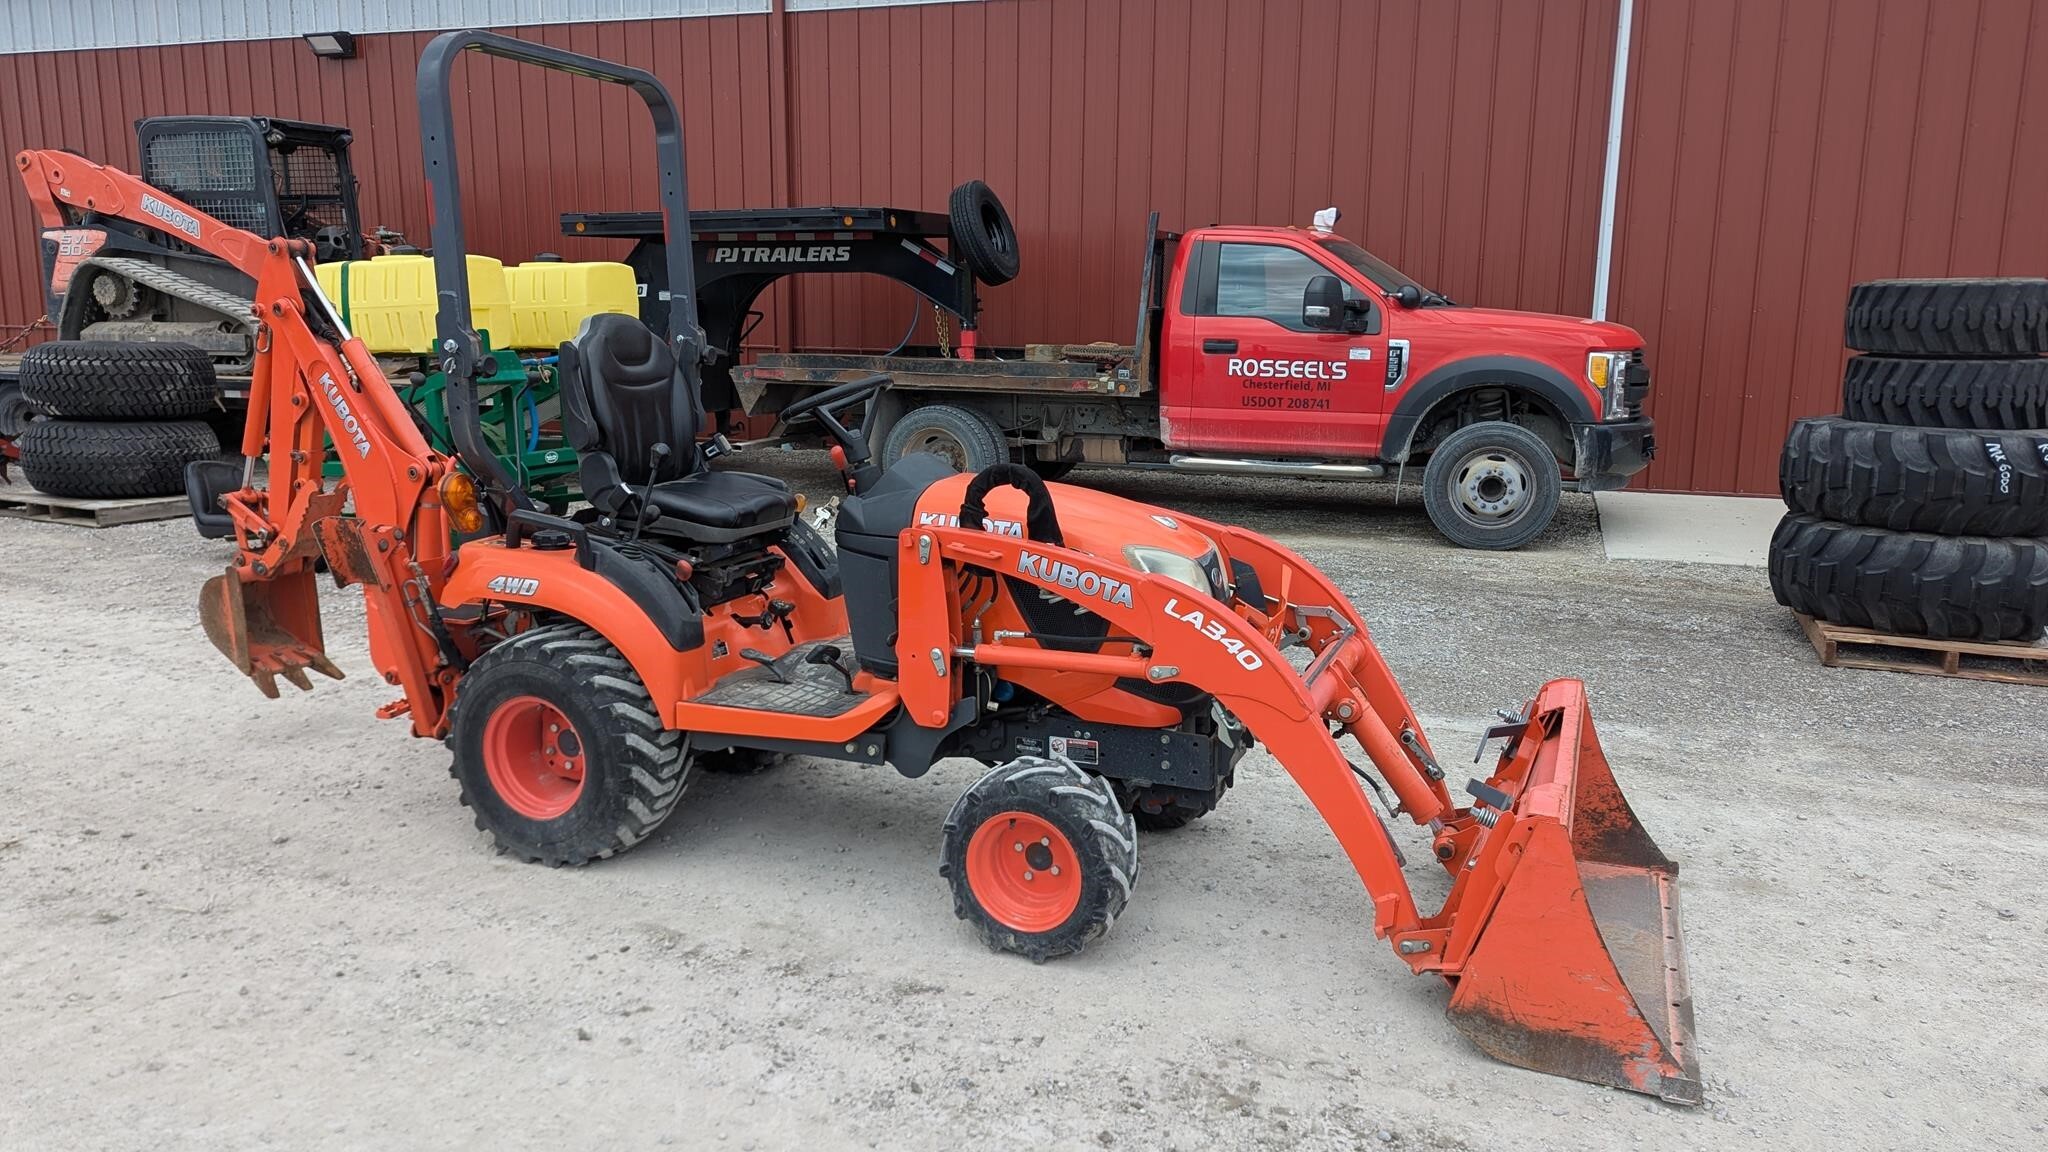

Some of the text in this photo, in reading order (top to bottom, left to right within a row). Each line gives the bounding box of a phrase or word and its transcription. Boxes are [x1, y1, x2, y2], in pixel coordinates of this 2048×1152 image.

[141, 194, 200, 239] KUBOTA
[62, 234, 93, 245] SVL
[714, 246, 851, 263] PJ TRAILERS
[1228, 358, 1347, 380] ROSSEEL'S
[1242, 379, 1331, 393] Chesterfield, MI
[1241, 396, 1331, 410] USDOT 208741
[318, 371, 371, 460] KUBOTA
[487, 575, 540, 597] 4WD
[1017, 549, 1134, 609] KUBOTA
[1164, 598, 1263, 671] LA340
